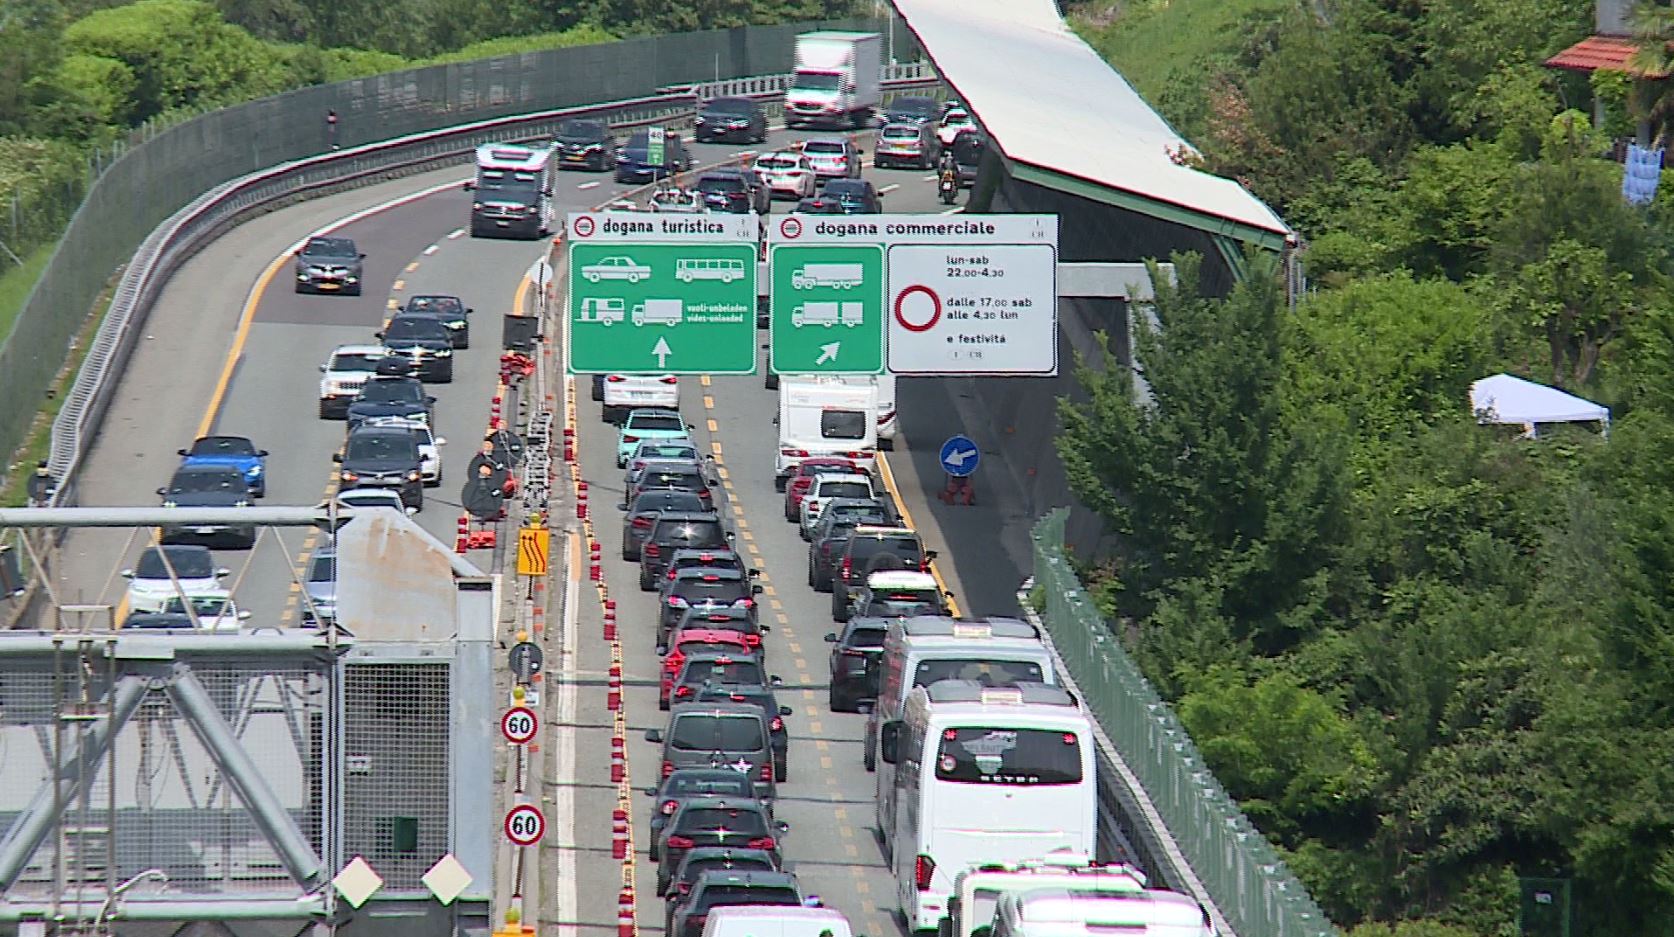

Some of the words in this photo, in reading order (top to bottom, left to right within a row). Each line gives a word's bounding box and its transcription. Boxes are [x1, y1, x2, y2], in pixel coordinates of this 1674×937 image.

[603, 218, 654, 235] dogana
[662, 218, 724, 234] turistica
[815, 221, 879, 236] dogana
[886, 220, 995, 235] commerciale
[946, 255, 989, 265] lun-sab
[946, 267, 1004, 277] 22.00-4.30
[946, 297, 976, 307] dalle
[980, 297, 1008, 307] 17.00
[1012, 297, 1033, 307] sab
[946, 310, 969, 320] alle
[1000, 310, 1019, 320] lun
[508, 717, 531, 734] 60
[513, 816, 536, 835] 60
